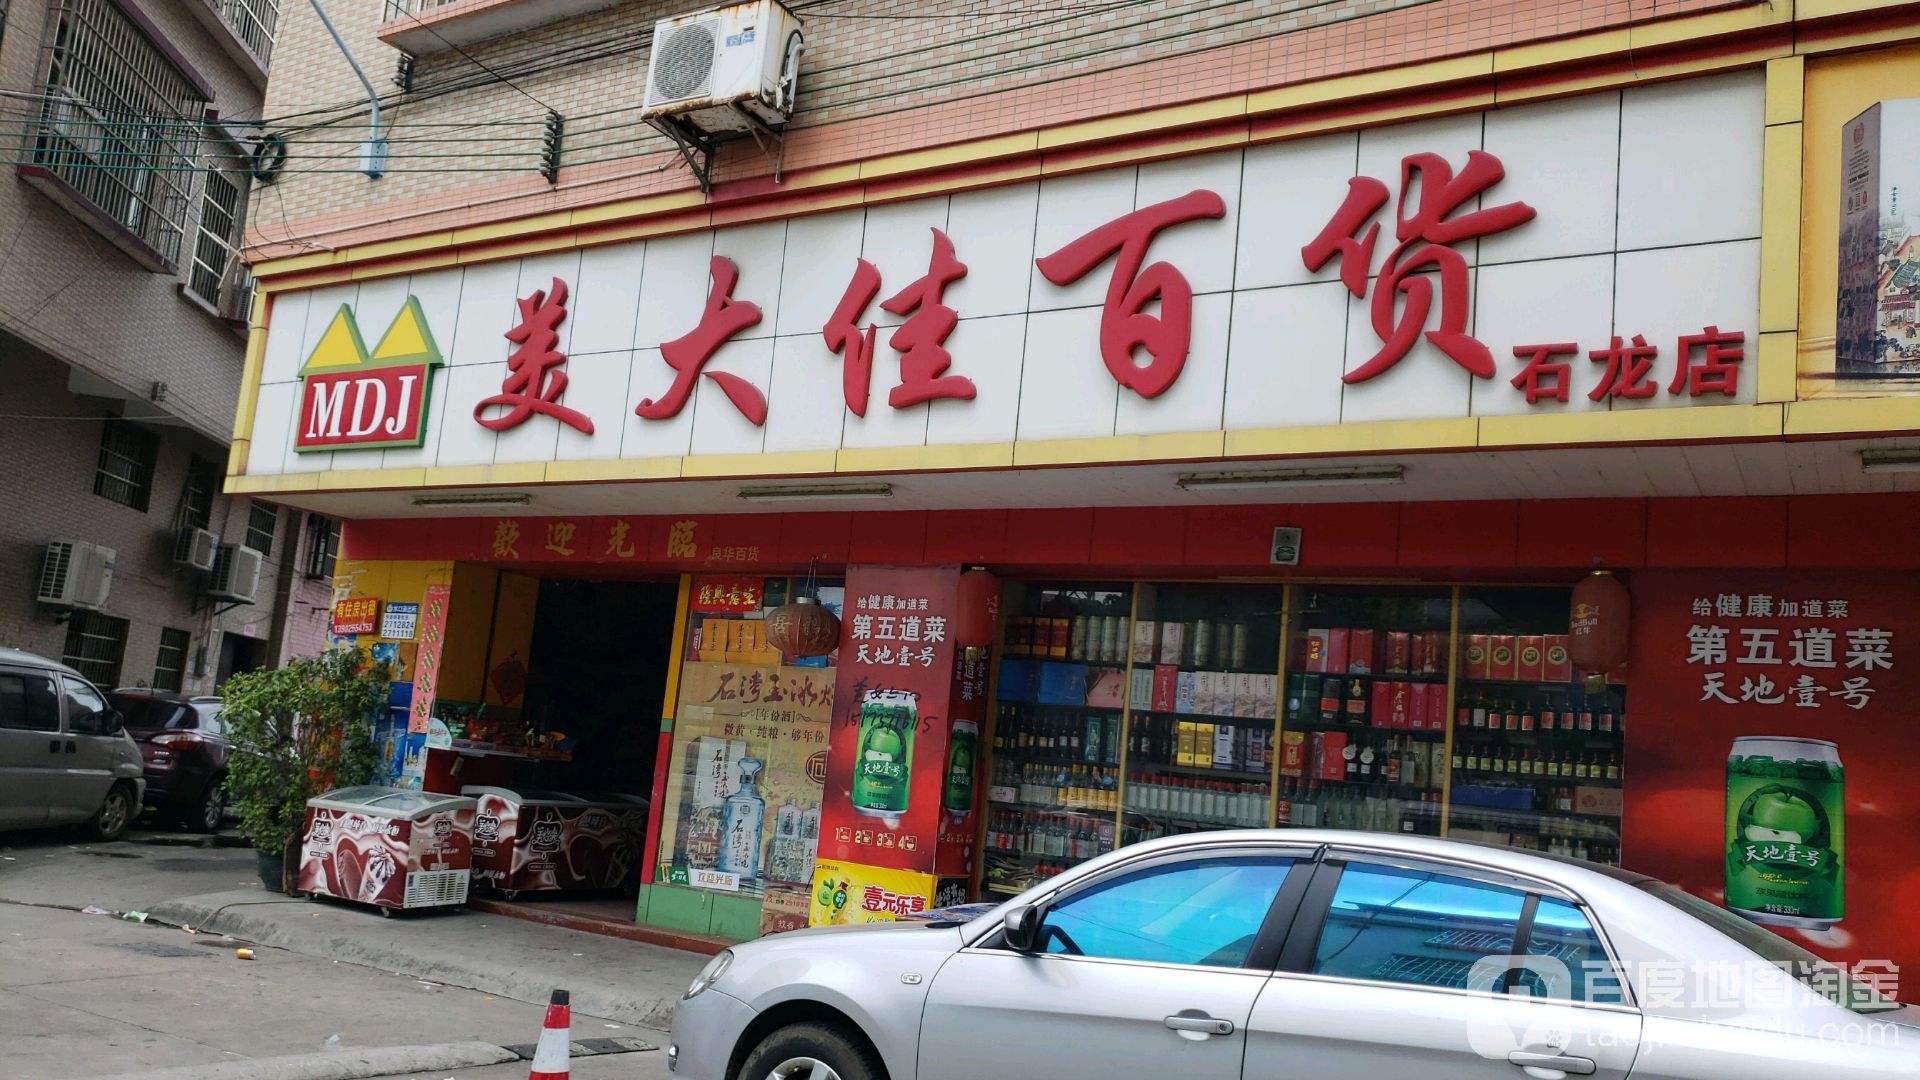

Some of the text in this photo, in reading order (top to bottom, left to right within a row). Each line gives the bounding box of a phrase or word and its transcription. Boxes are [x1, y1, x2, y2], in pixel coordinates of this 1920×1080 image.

[473, 149, 1538, 436] 美大佳百货
[1510, 325, 1746, 404] 石龙店
[305, 375, 418, 439] MDJ
[856, 593, 929, 611] 给健康加道菜
[1692, 593, 1850, 619] 给健康加道菜
[851, 613, 946, 644] 第五道菜
[855, 643, 936, 669] 天地壹号
[1685, 624, 1895, 671] 第五道菜
[1699, 671, 1876, 710] 天地壹号
[863, 761, 901, 777] 天地壹号
[1745, 843, 1822, 867] 天地壹号
[862, 885, 928, 915] 壹元乐享
